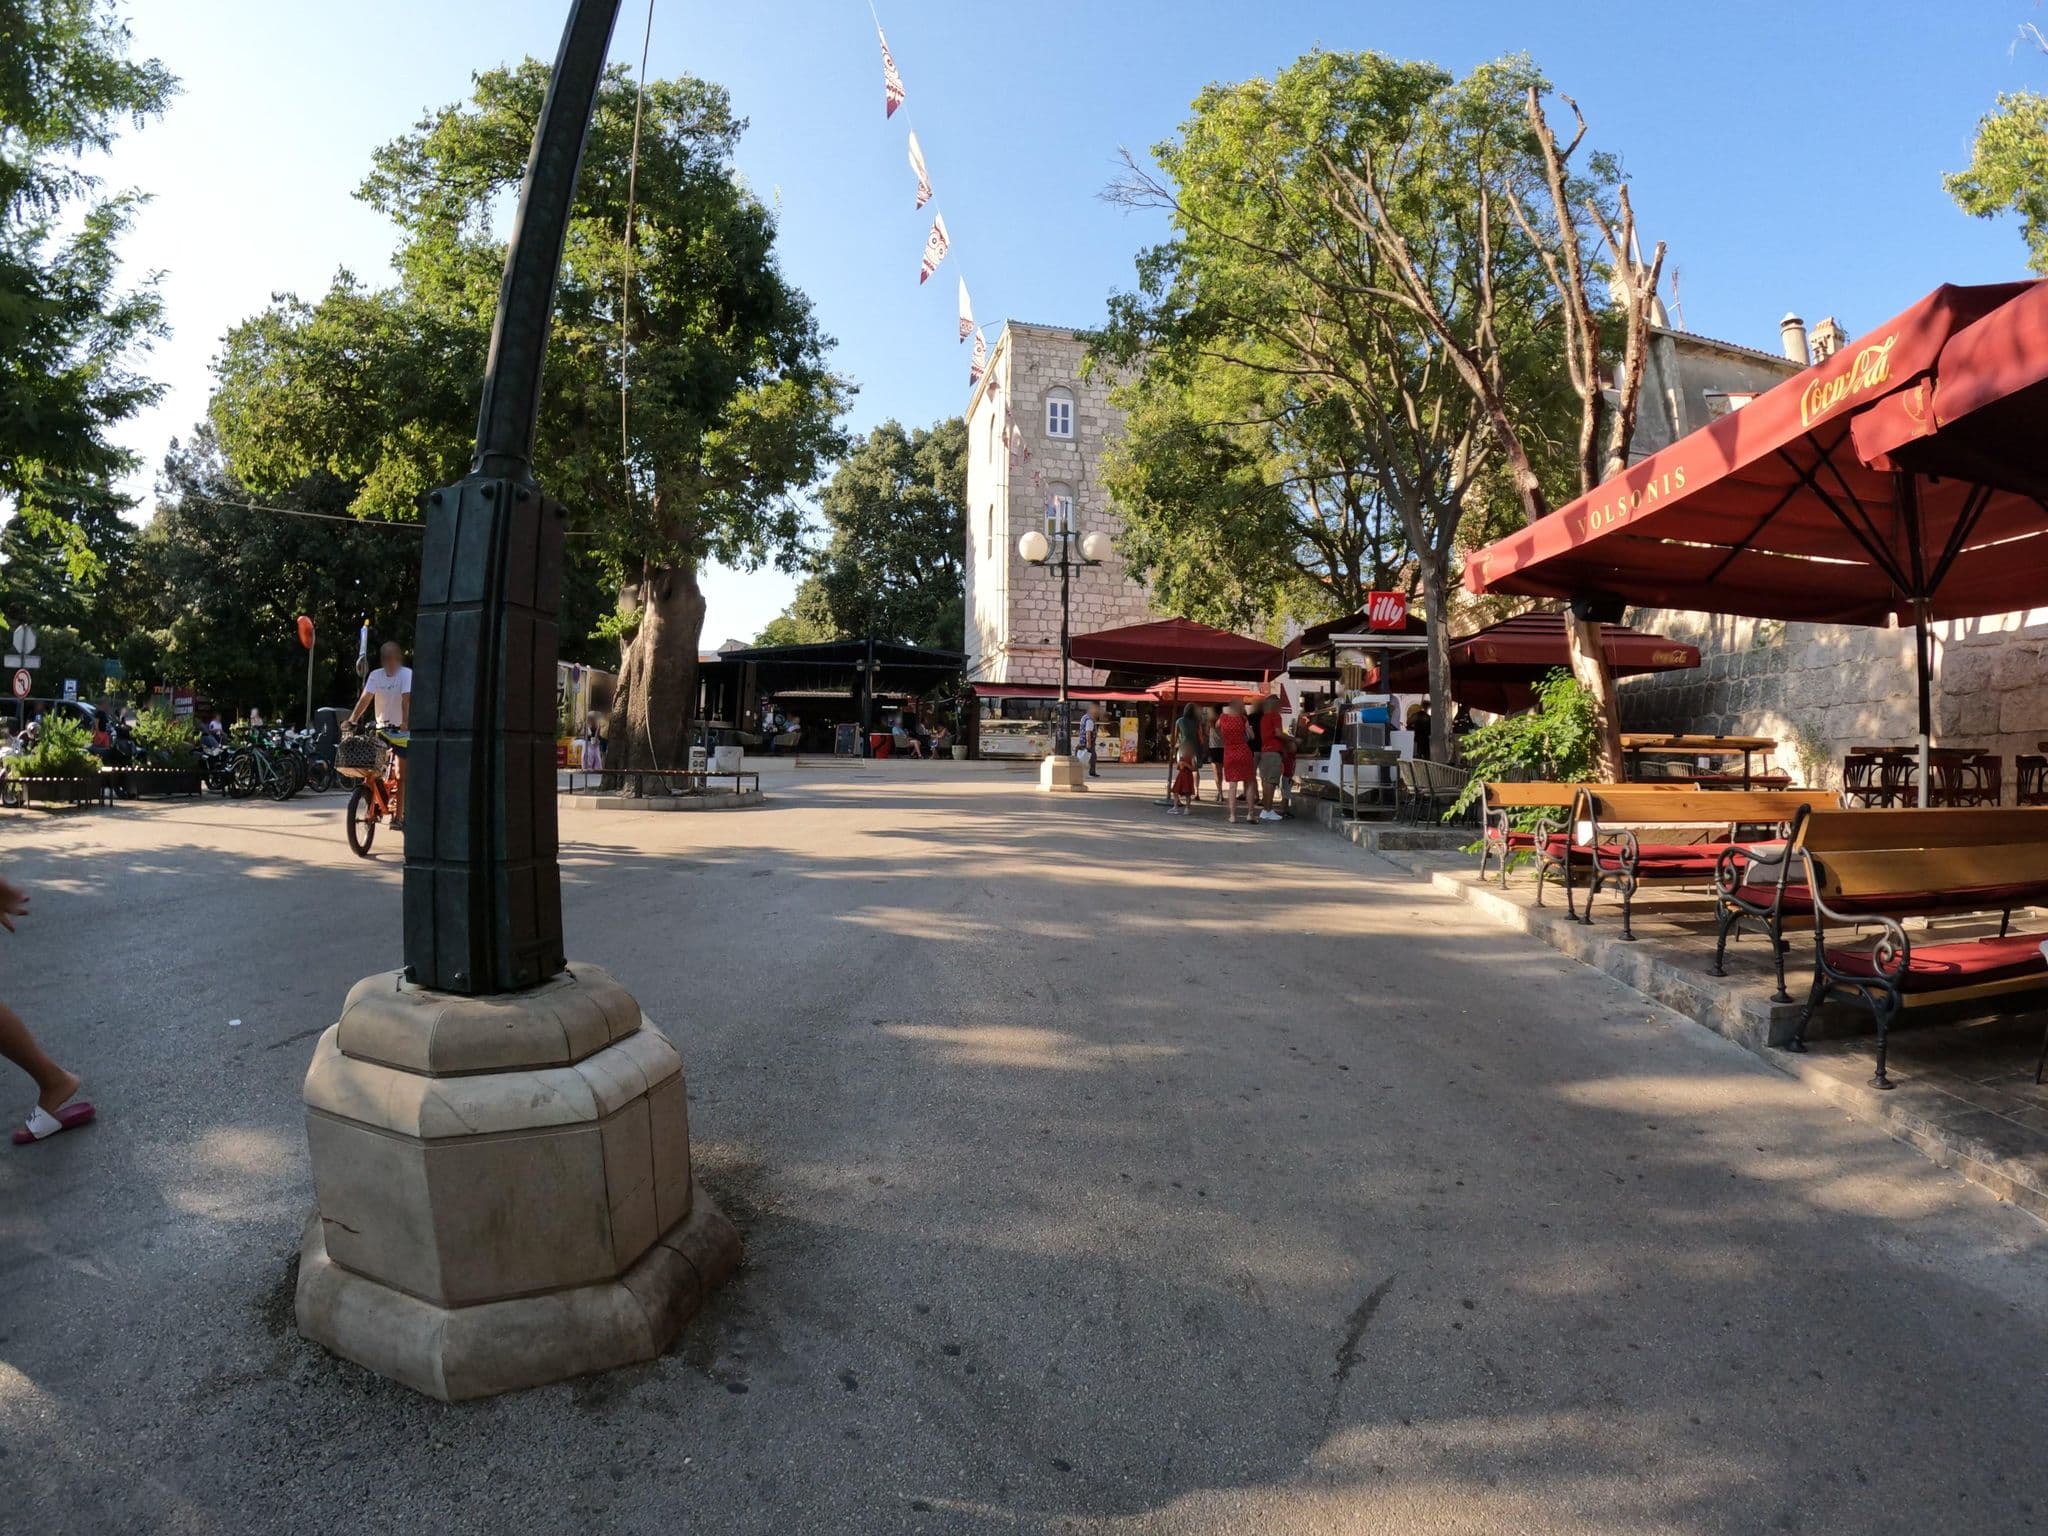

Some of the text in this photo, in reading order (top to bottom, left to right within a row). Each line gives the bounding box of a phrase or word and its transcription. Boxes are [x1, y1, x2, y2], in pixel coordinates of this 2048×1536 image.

[1801, 333, 1899, 427] Coca-Cola
[1578, 466, 1686, 535] VOLSONIS
[1372, 596, 1404, 626] illy
